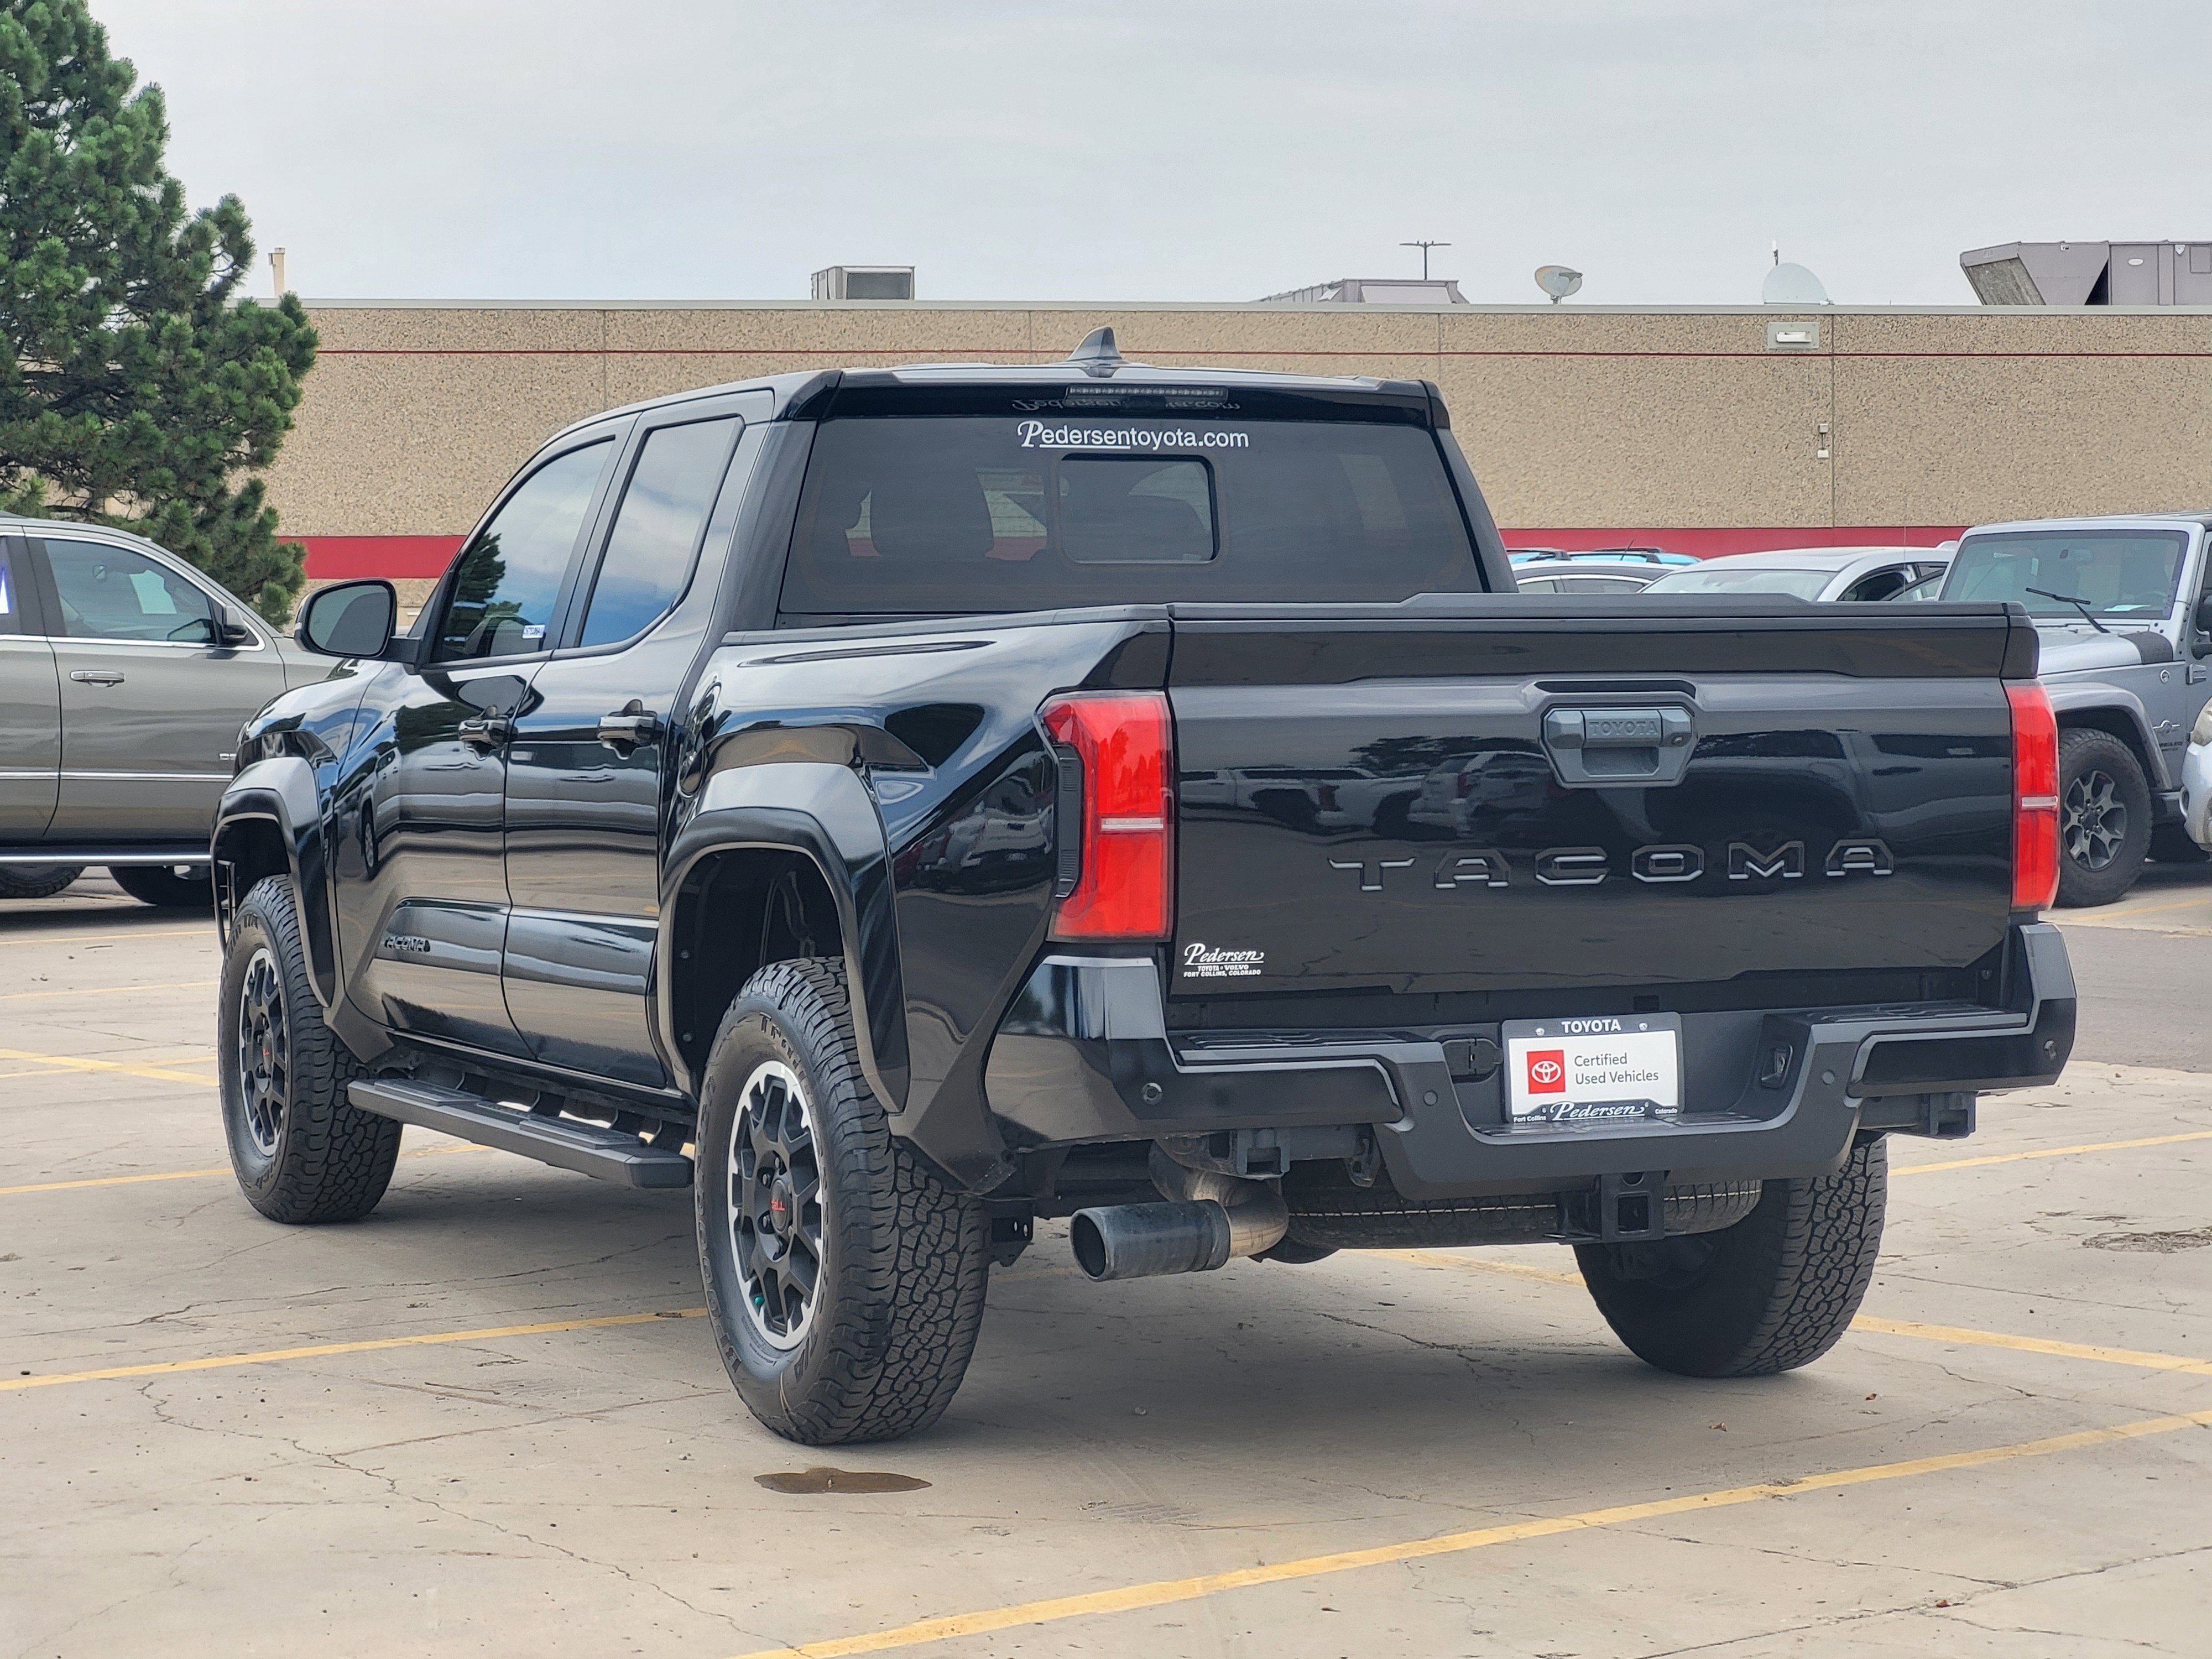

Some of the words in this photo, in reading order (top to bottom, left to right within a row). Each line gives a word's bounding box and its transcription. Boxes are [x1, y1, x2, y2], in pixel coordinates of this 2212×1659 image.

[1018, 420, 1249, 450] Pedersentoyota.com
[1589, 721, 1658, 736] TOYOTA
[1329, 839, 1893, 891] TACOMA
[1184, 943, 1264, 966] Pedersen
[1561, 1019, 1622, 1034] TOYOTA
[1574, 1052, 1628, 1067] Certified
[1575, 1071, 1606, 1084] Used
[1609, 1069, 1659, 1083] Vehicles
[1550, 1101, 1645, 1121] Pedersen
